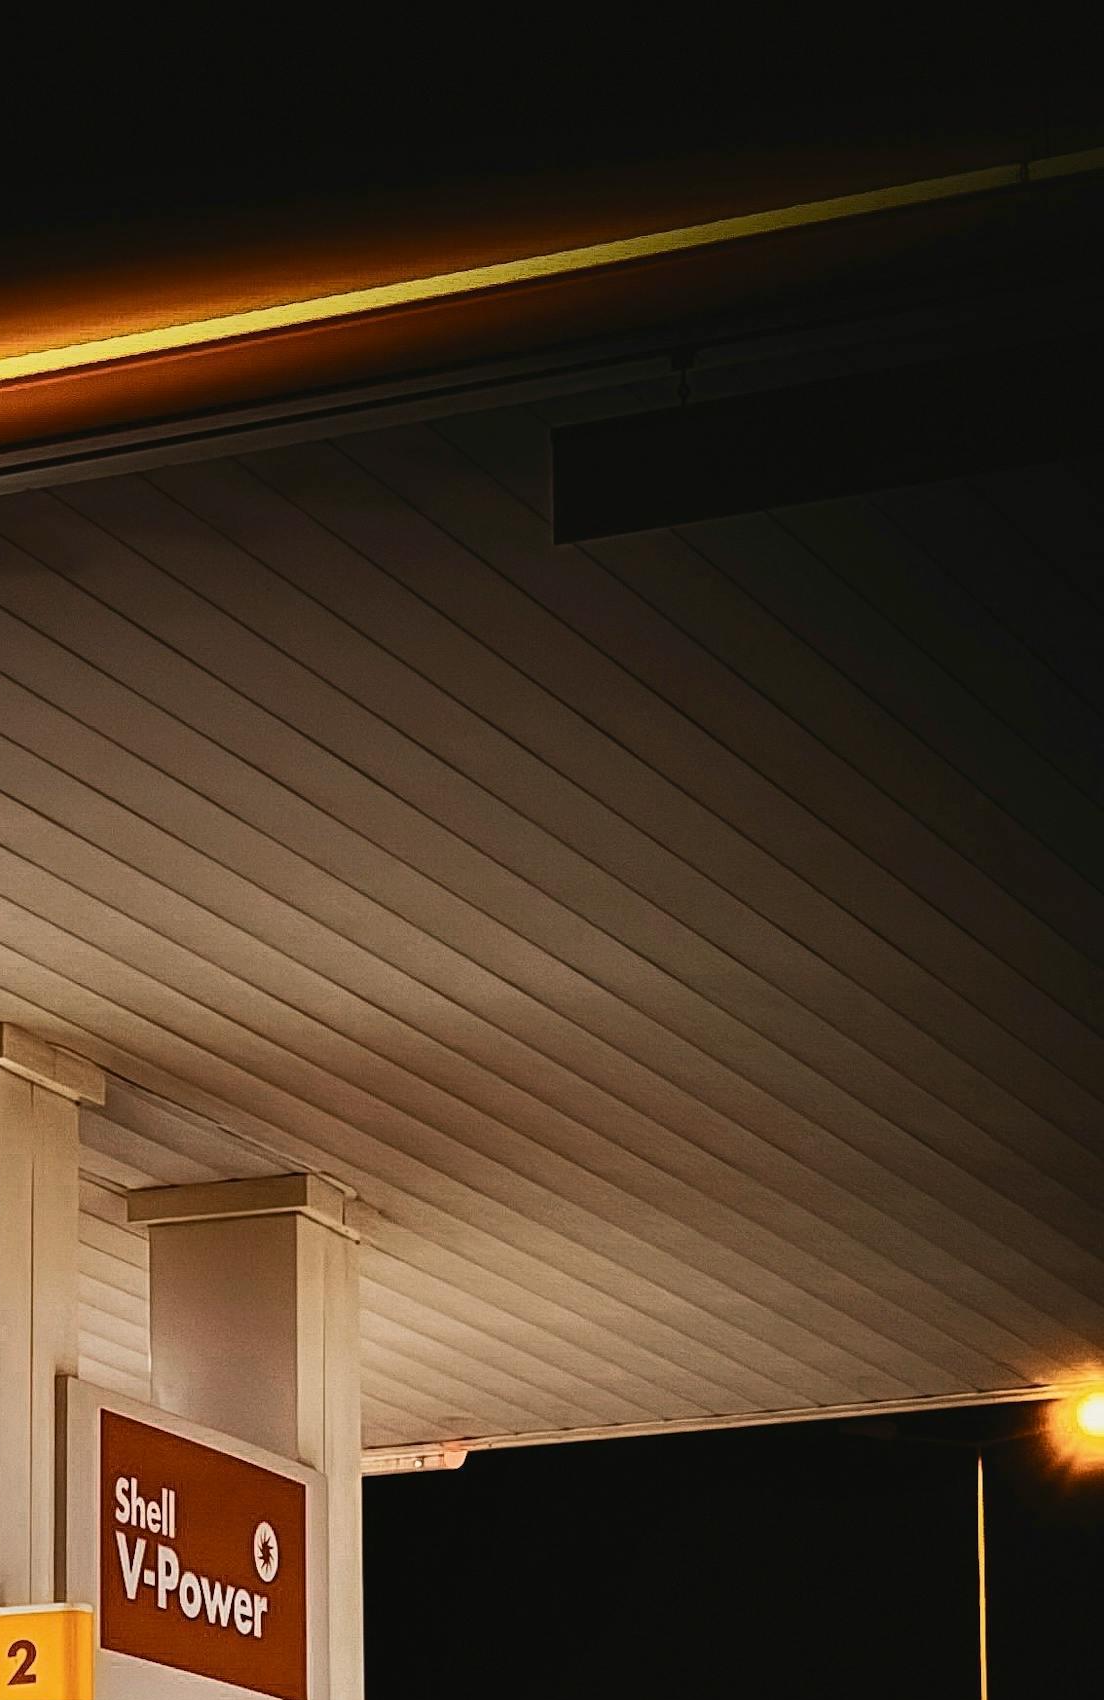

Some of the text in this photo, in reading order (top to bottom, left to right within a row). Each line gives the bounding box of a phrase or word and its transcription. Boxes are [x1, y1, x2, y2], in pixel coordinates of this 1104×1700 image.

[115, 1476, 175, 1539] Shell
[115, 1530, 268, 1638] V-Power
[7, 1639, 37, 1686] 2
